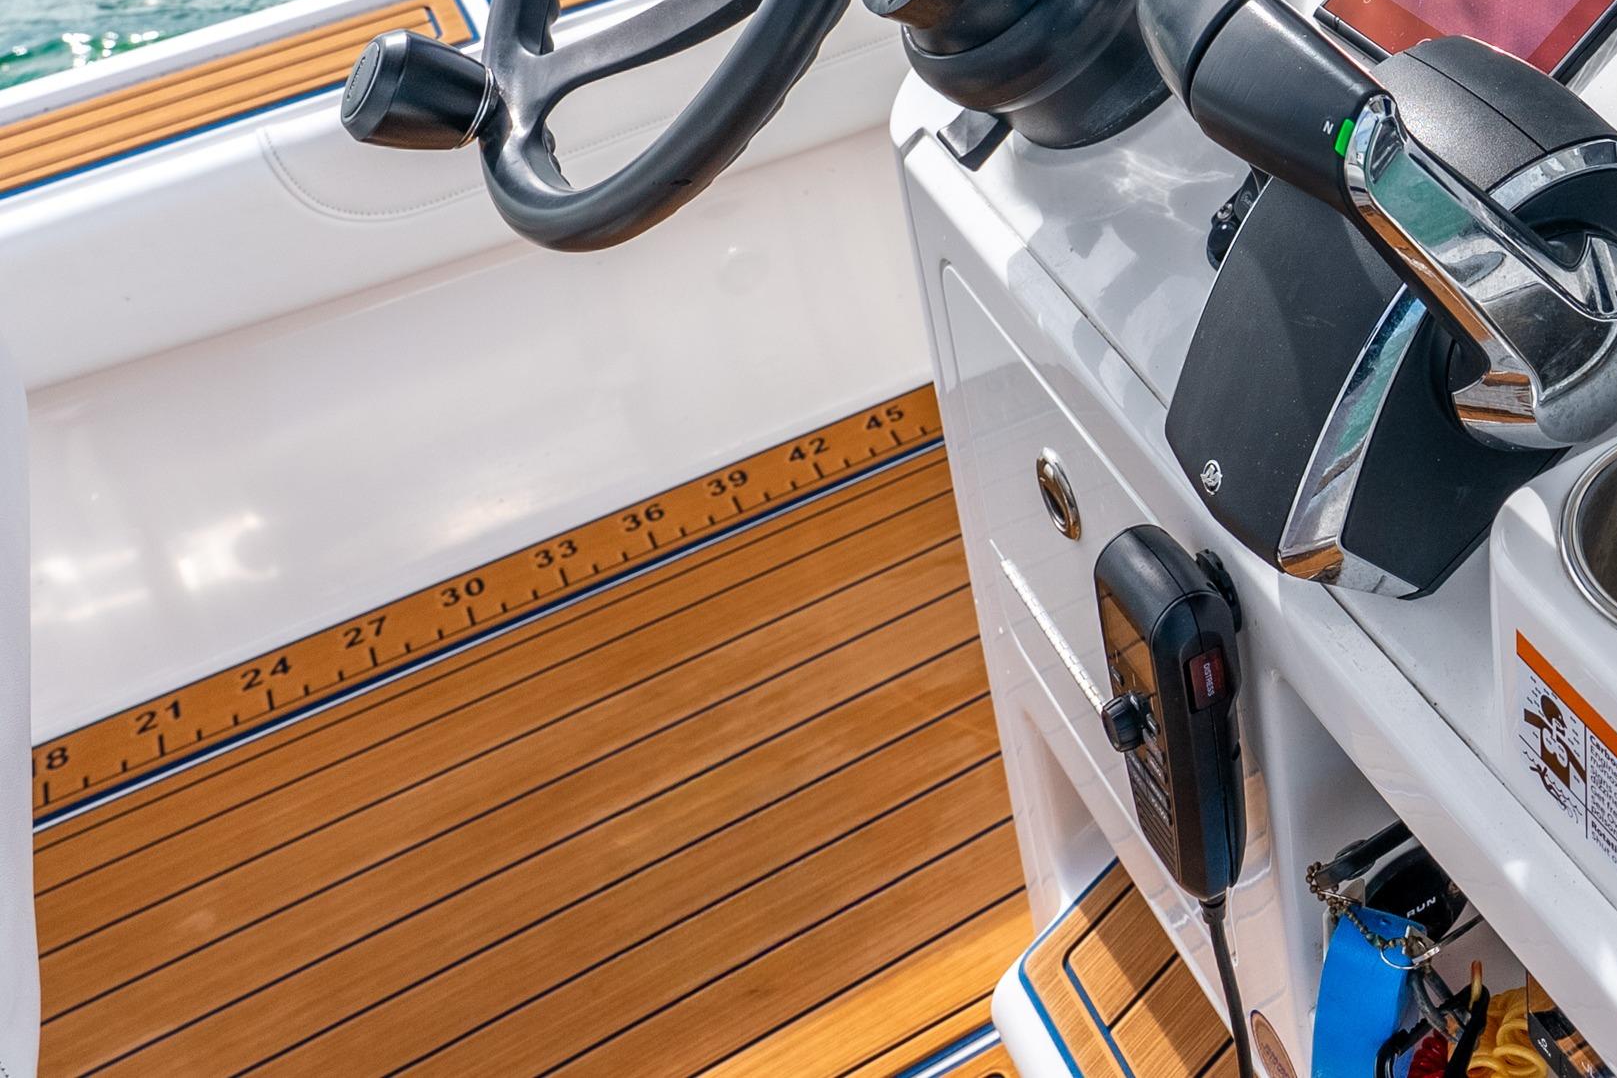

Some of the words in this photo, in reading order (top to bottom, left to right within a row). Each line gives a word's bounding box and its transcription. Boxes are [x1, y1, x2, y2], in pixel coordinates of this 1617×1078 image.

[1322, 120, 1334, 135] N
[865, 405, 906, 431] 45
[788, 437, 830, 463] 42
[707, 469, 749, 498] 39
[622, 503, 665, 534] 36
[534, 539, 579, 570] 33
[441, 577, 487, 608] 30
[343, 615, 388, 649] 27
[239, 656, 293, 691] 24
[1203, 662, 1215, 697] DISTRESS
[134, 699, 183, 735] 21
[1590, 746, 1617, 781] Engine
[1590, 765, 1612, 795] Signs
[1592, 831, 1609, 856] Shut
[1406, 896, 1436, 919] RUN
